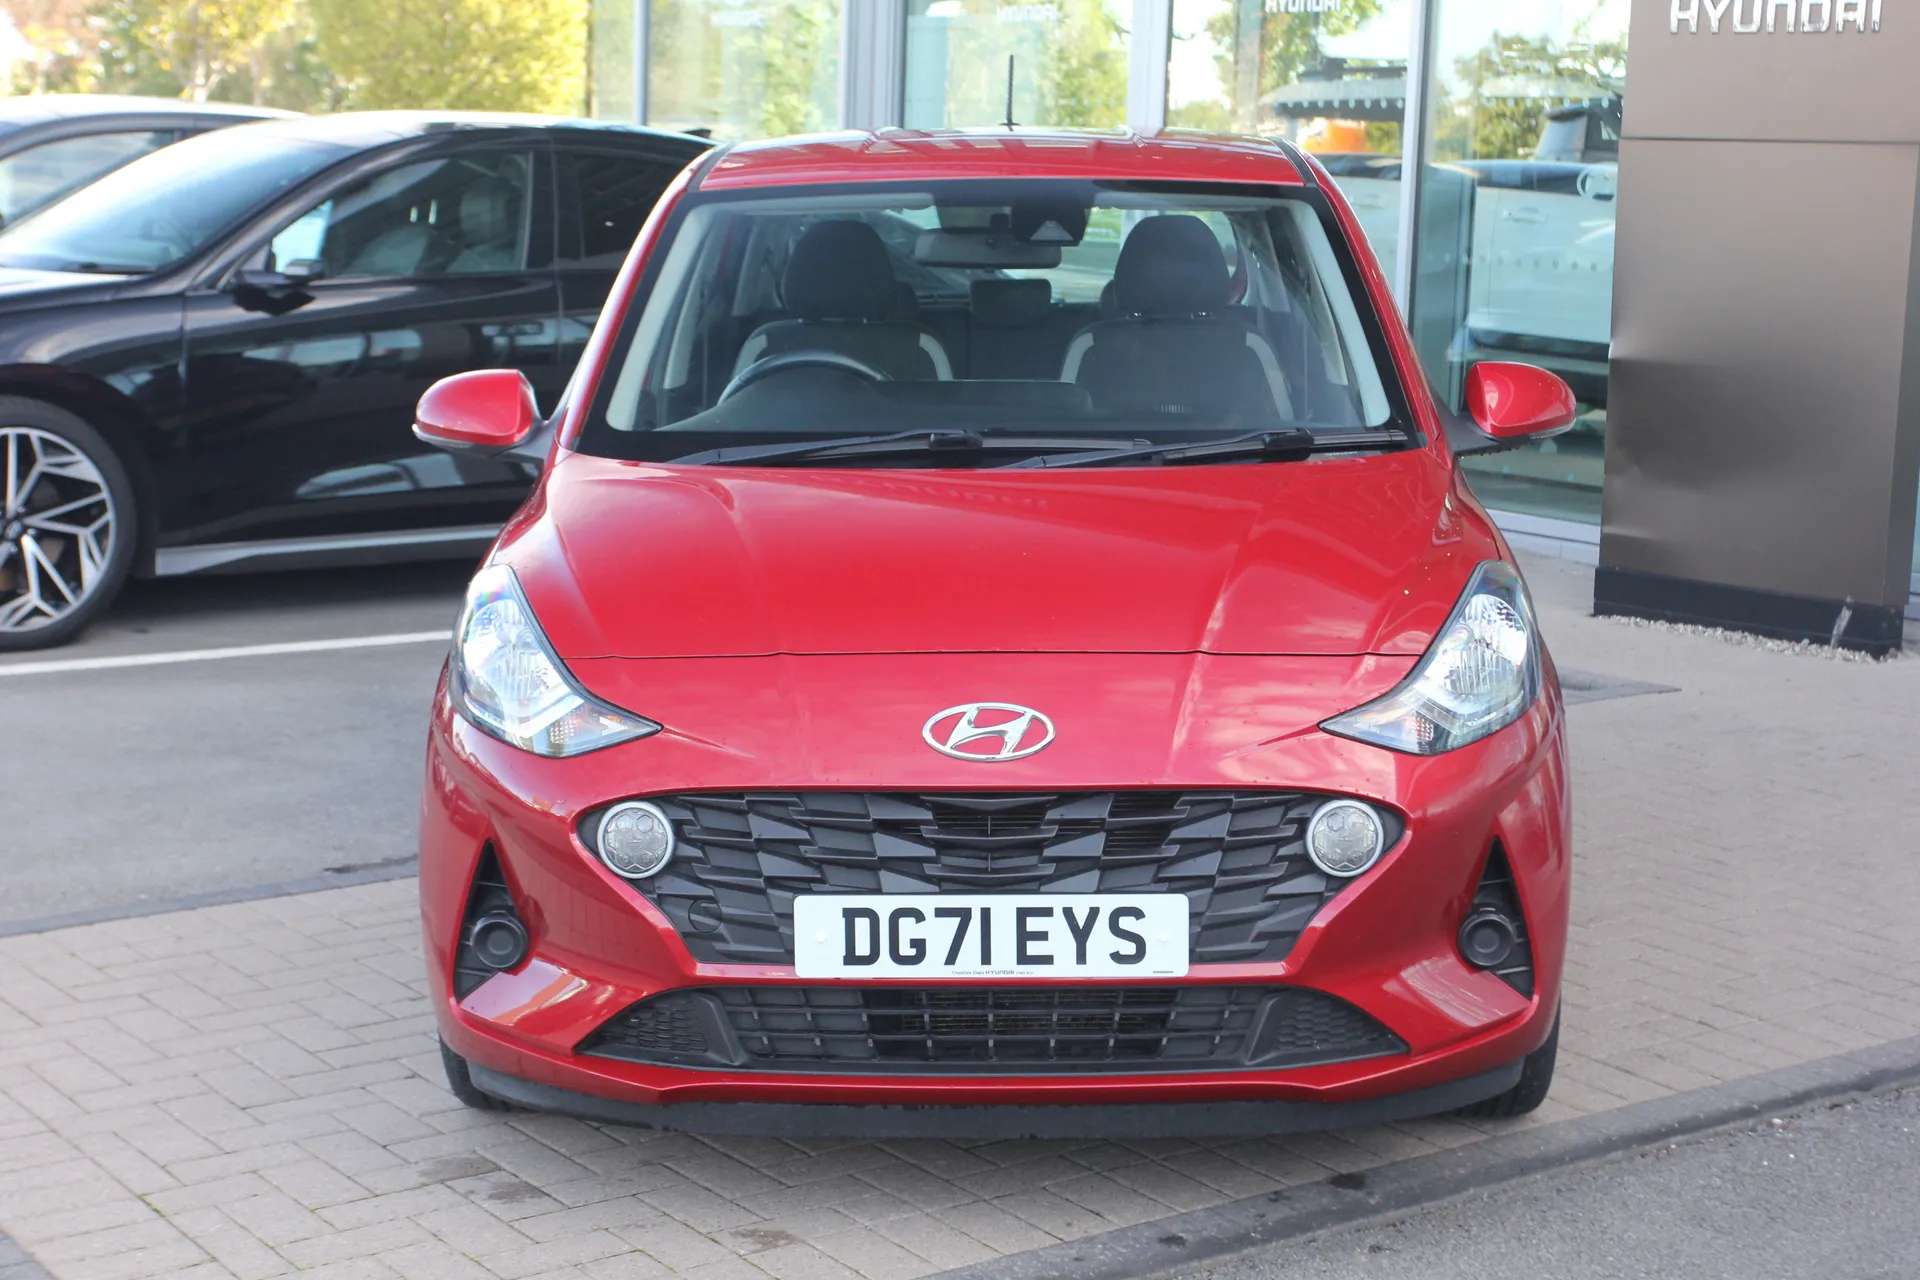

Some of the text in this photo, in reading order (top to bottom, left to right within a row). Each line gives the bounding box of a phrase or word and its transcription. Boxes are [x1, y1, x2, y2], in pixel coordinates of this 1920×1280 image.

[1670, 0, 1882, 33] HYUNDAI
[842, 906, 1147, 965] DG71 EYS
